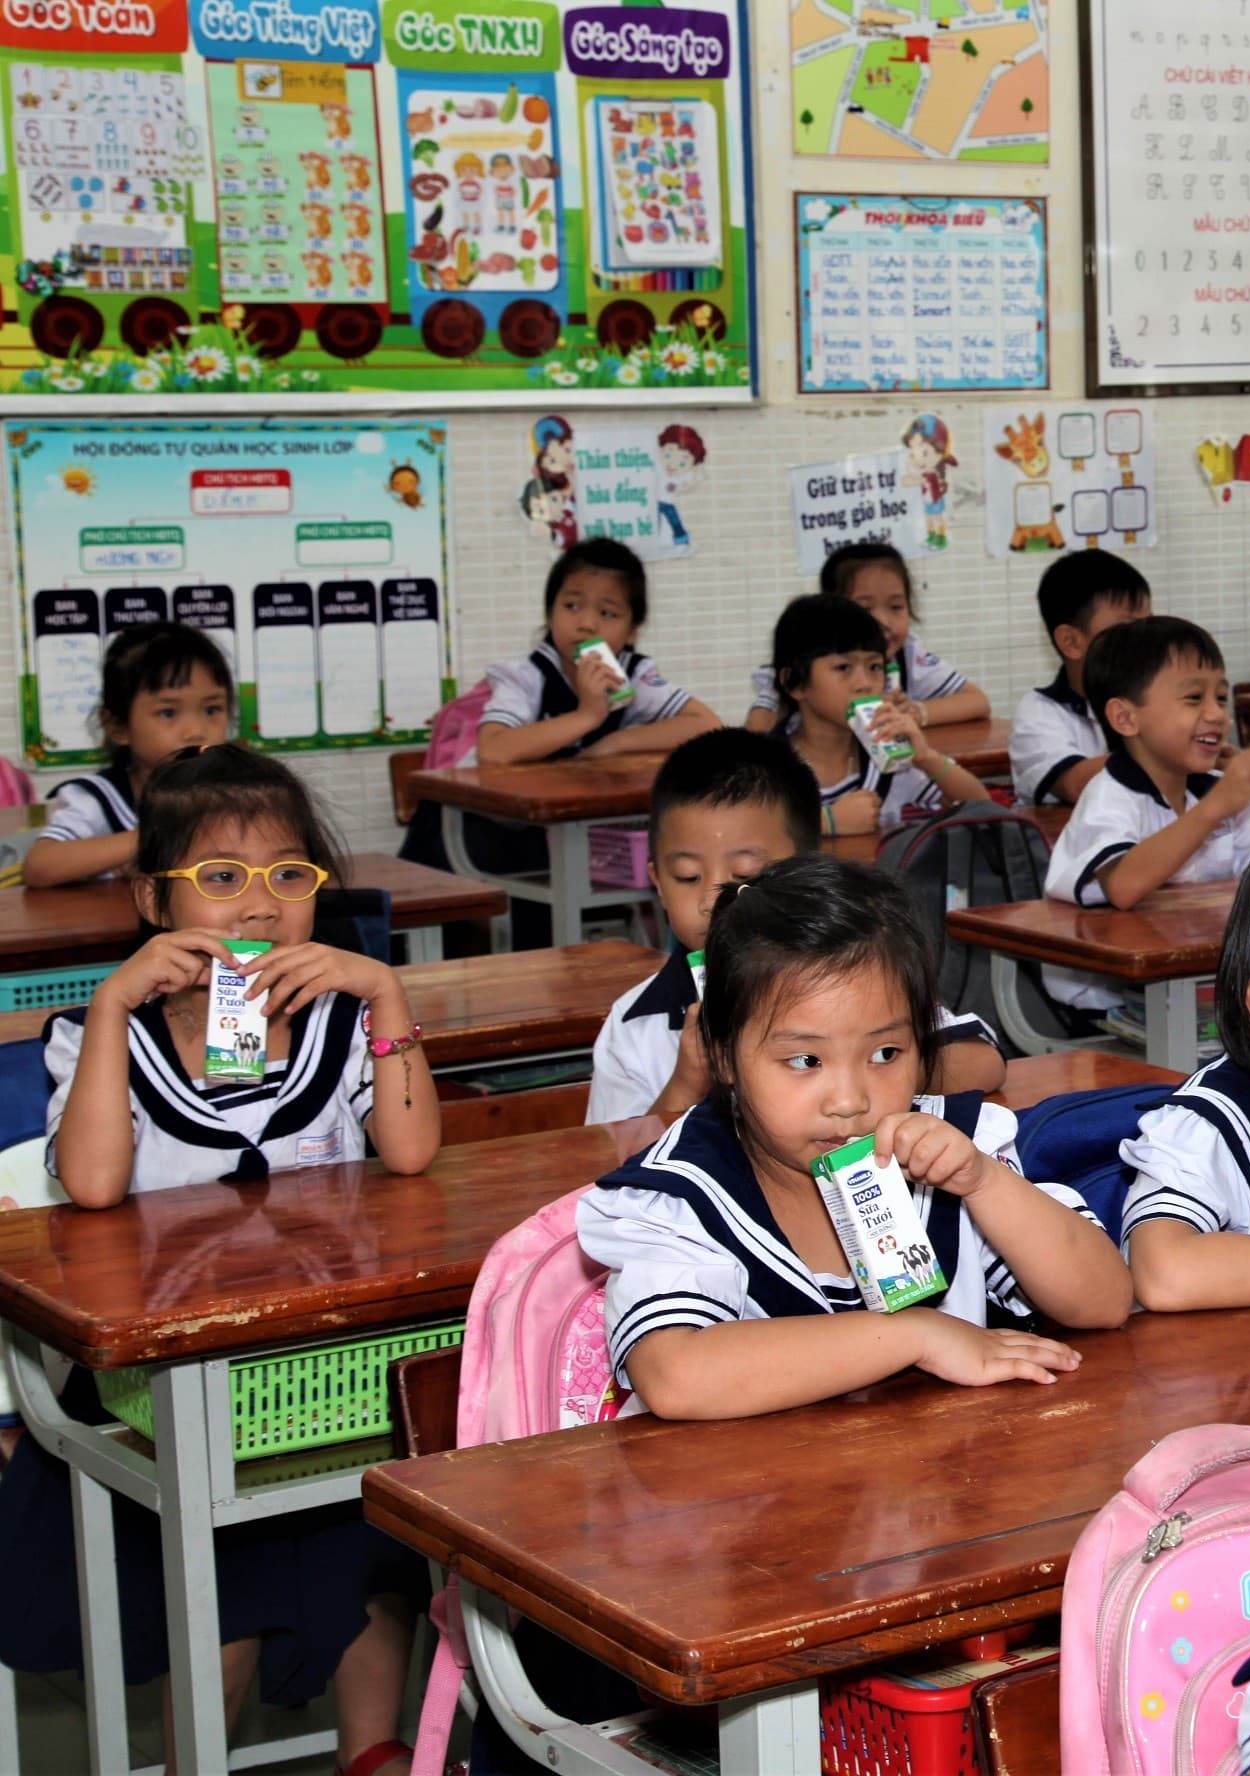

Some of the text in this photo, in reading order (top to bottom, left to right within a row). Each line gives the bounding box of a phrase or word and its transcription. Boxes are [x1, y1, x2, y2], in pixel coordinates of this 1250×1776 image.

[203, 2, 249, 38] Góc
[323, 8, 373, 57] Việt
[399, 14, 540, 51] Góc TNXH
[575, 23, 720, 73] Góc Sáng tạo
[56, 68, 72, 89] 2
[123, 71, 138, 91] 4
[160, 74, 175, 96] 5
[24, 119, 41, 141] 6
[61, 119, 77, 140] 7
[103, 120, 117, 143] 8
[140, 122, 157, 145] 9
[1135, 250, 1146, 272] 0
[1161, 250, 1168, 271] 1
[1183, 250, 1193, 271] 2
[1208, 250, 1217, 271] 3
[1231, 249, 1243, 270] 4
[1136, 316, 1149, 337] 2
[1169, 315, 1179, 335] 3
[1201, 314, 1211, 335] 4
[1231, 313, 1241, 335] 5
[73, 441, 105, 458] HỘI
[109, 438, 160, 456] ĐỒNG
[165, 441, 186, 459] TỰ
[243, 442, 278, 459] HỌC
[281, 441, 320, 456] SINH
[324, 439, 354, 455] LỚP
[807, 468, 896, 499] Giữ trật tự
[801, 499, 907, 530] trong giờ học
[217, 986, 237, 996] Sữa
[219, 977, 245, 986] 100%
[853, 1186, 881, 1204] 100%
[858, 1204, 880, 1217] Sữa
[862, 1207, 893, 1228] Tươi
